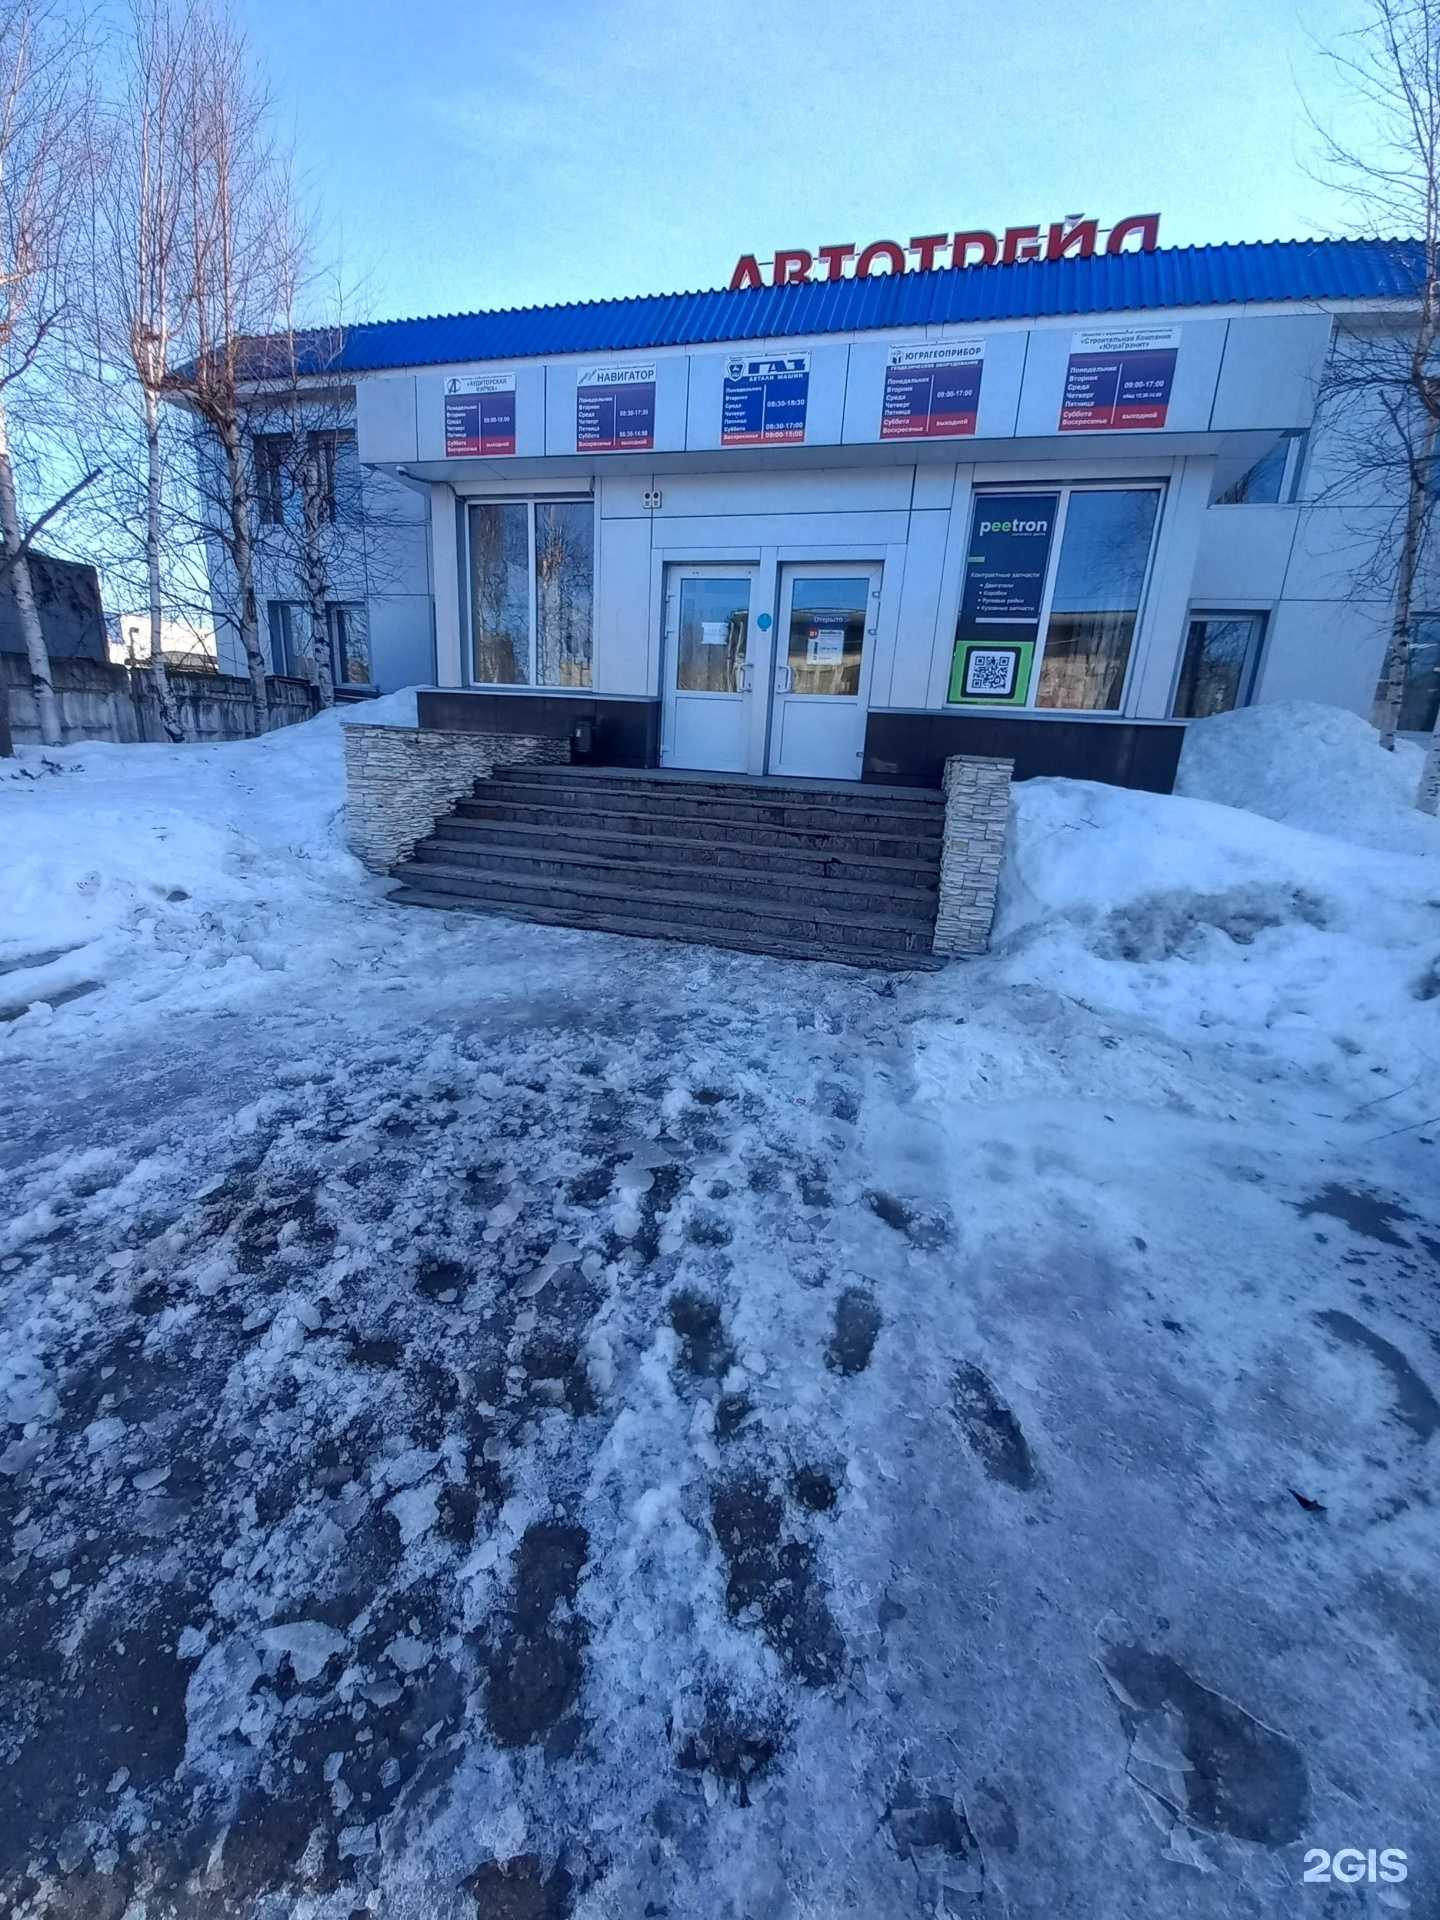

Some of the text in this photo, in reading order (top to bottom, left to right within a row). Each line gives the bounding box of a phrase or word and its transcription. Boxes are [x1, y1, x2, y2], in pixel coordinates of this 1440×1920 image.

[729, 213, 1161, 290] АВТОТРЕЙД
[905, 347, 981, 360] ЮГРАГЕОПРИБОР
[748, 359, 805, 374] ГАЗ
[597, 369, 654, 382] НАВИГАТОР
[1063, 411, 1092, 419] Суббота
[979, 519, 1048, 536] peetron
